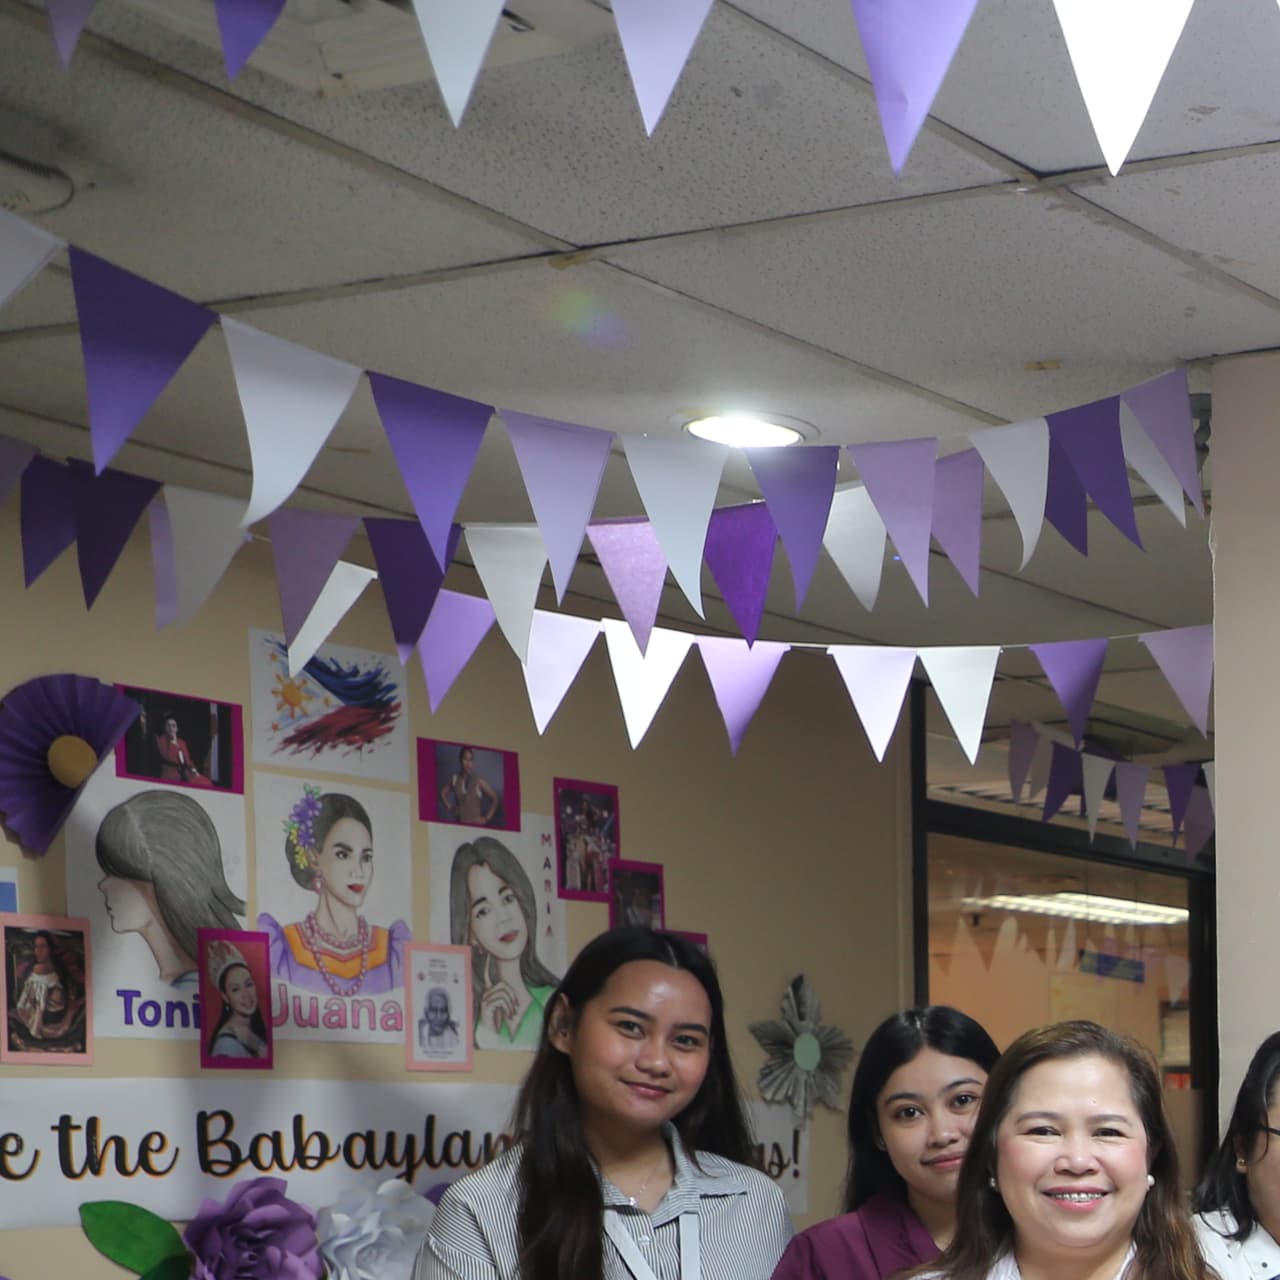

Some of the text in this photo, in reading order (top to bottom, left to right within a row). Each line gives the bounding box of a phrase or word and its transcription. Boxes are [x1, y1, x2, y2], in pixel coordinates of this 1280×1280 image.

[541, 832, 553, 937] MARIA
[272, 983, 404, 1032] Juana
[51, 1114, 180, 1179] the
